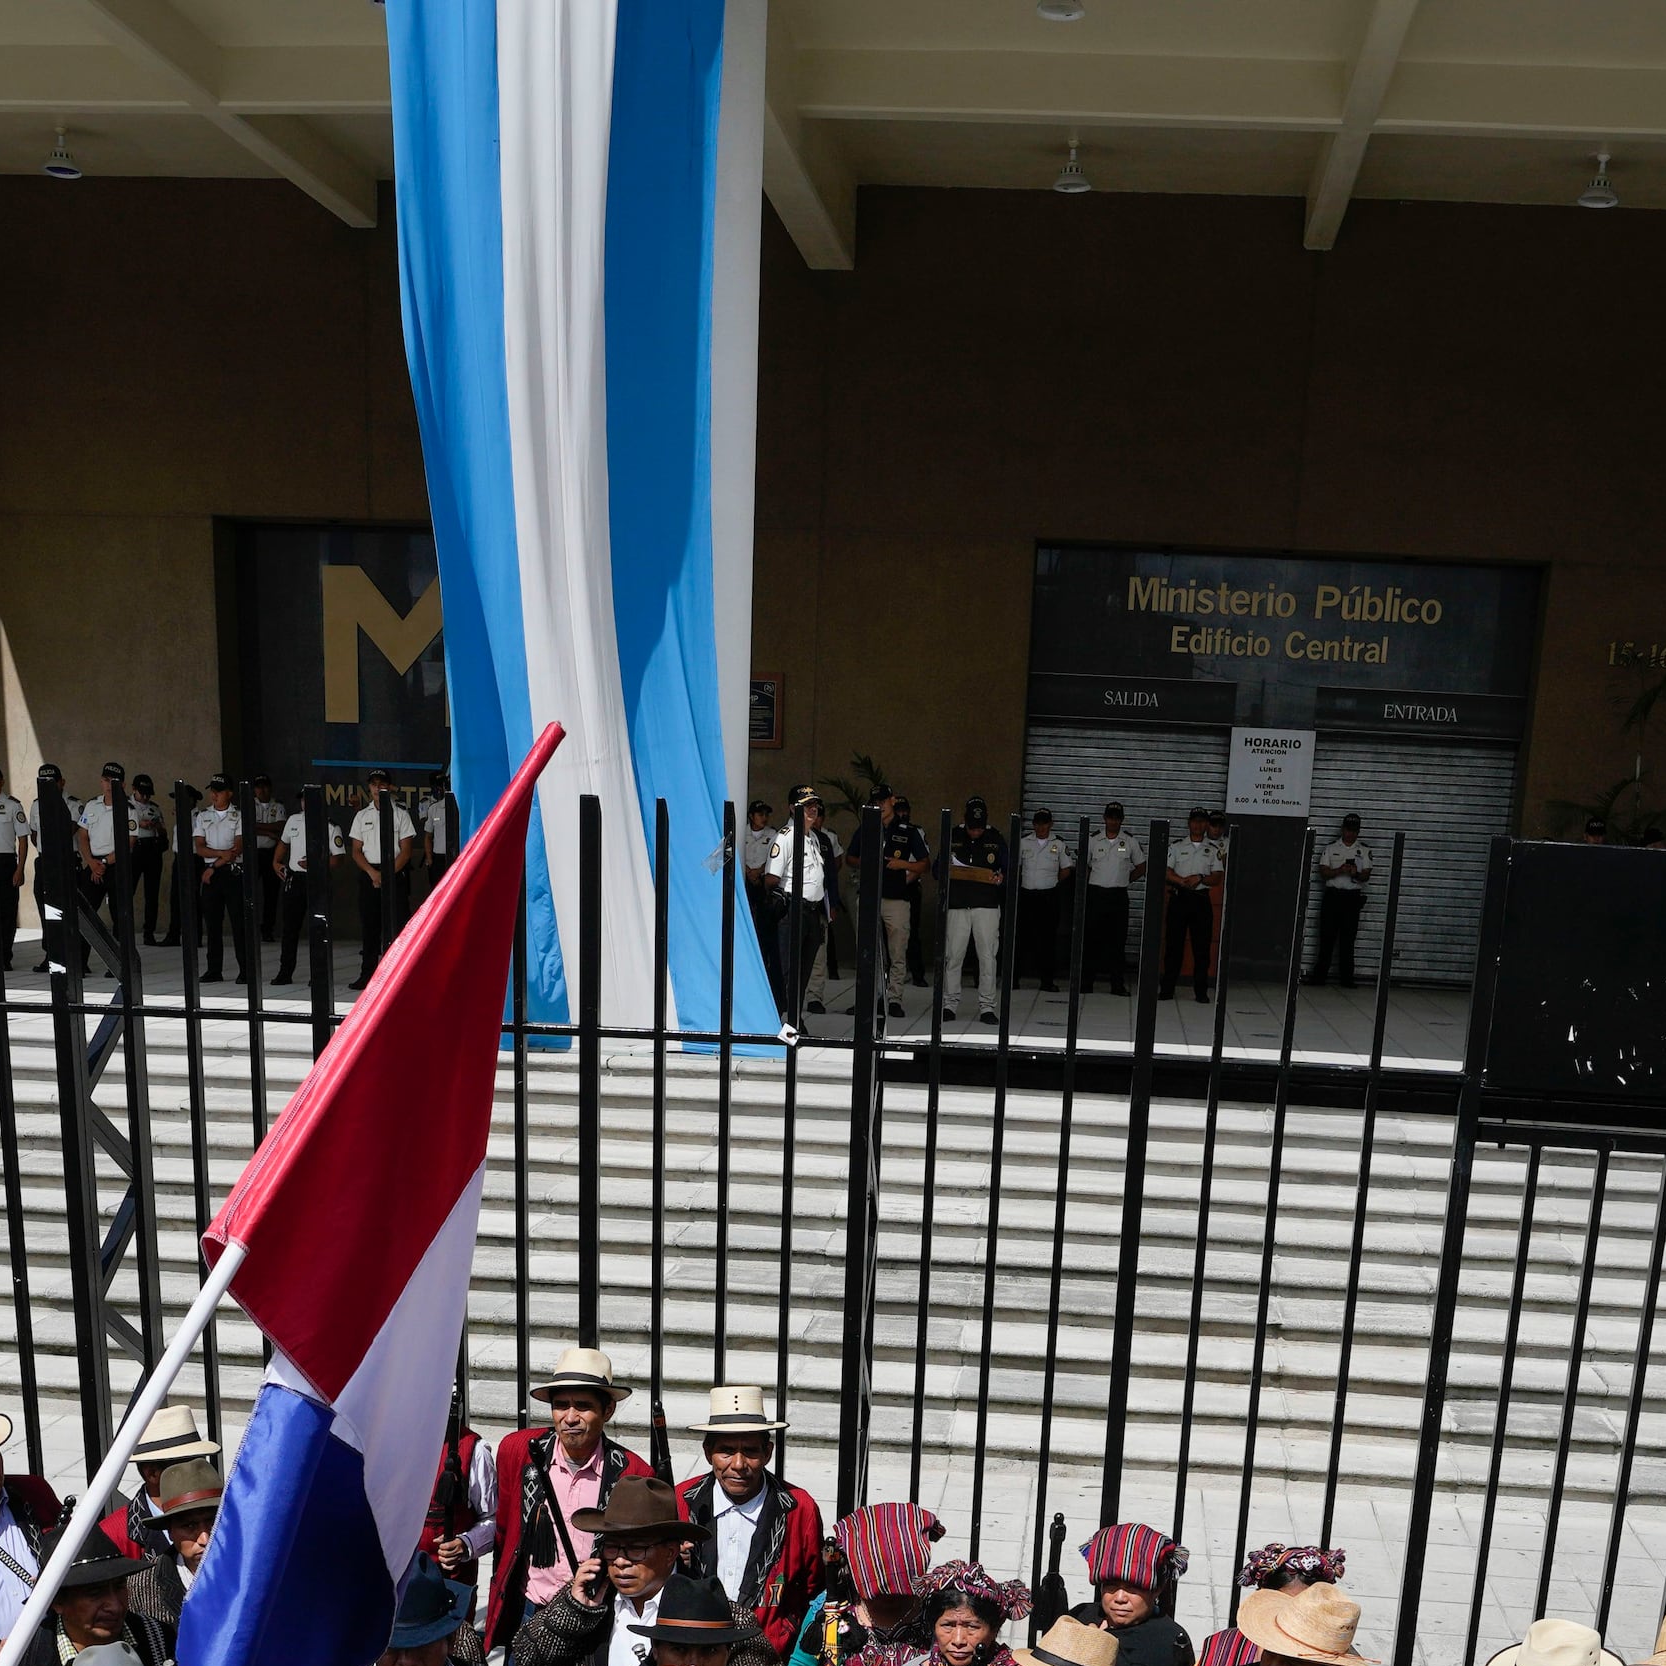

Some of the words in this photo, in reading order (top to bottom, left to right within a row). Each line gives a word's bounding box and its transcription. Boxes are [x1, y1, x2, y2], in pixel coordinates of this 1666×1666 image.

[1127, 576, 1297, 619] Ministerio
[1314, 583, 1443, 625] Público
[1170, 625, 1271, 657] Edificio
[1284, 630, 1389, 665] Central
[1104, 690, 1160, 709] SALIDA
[1383, 704, 1459, 723] ENTRADA
[1244, 737, 1302, 749] HORARIO
